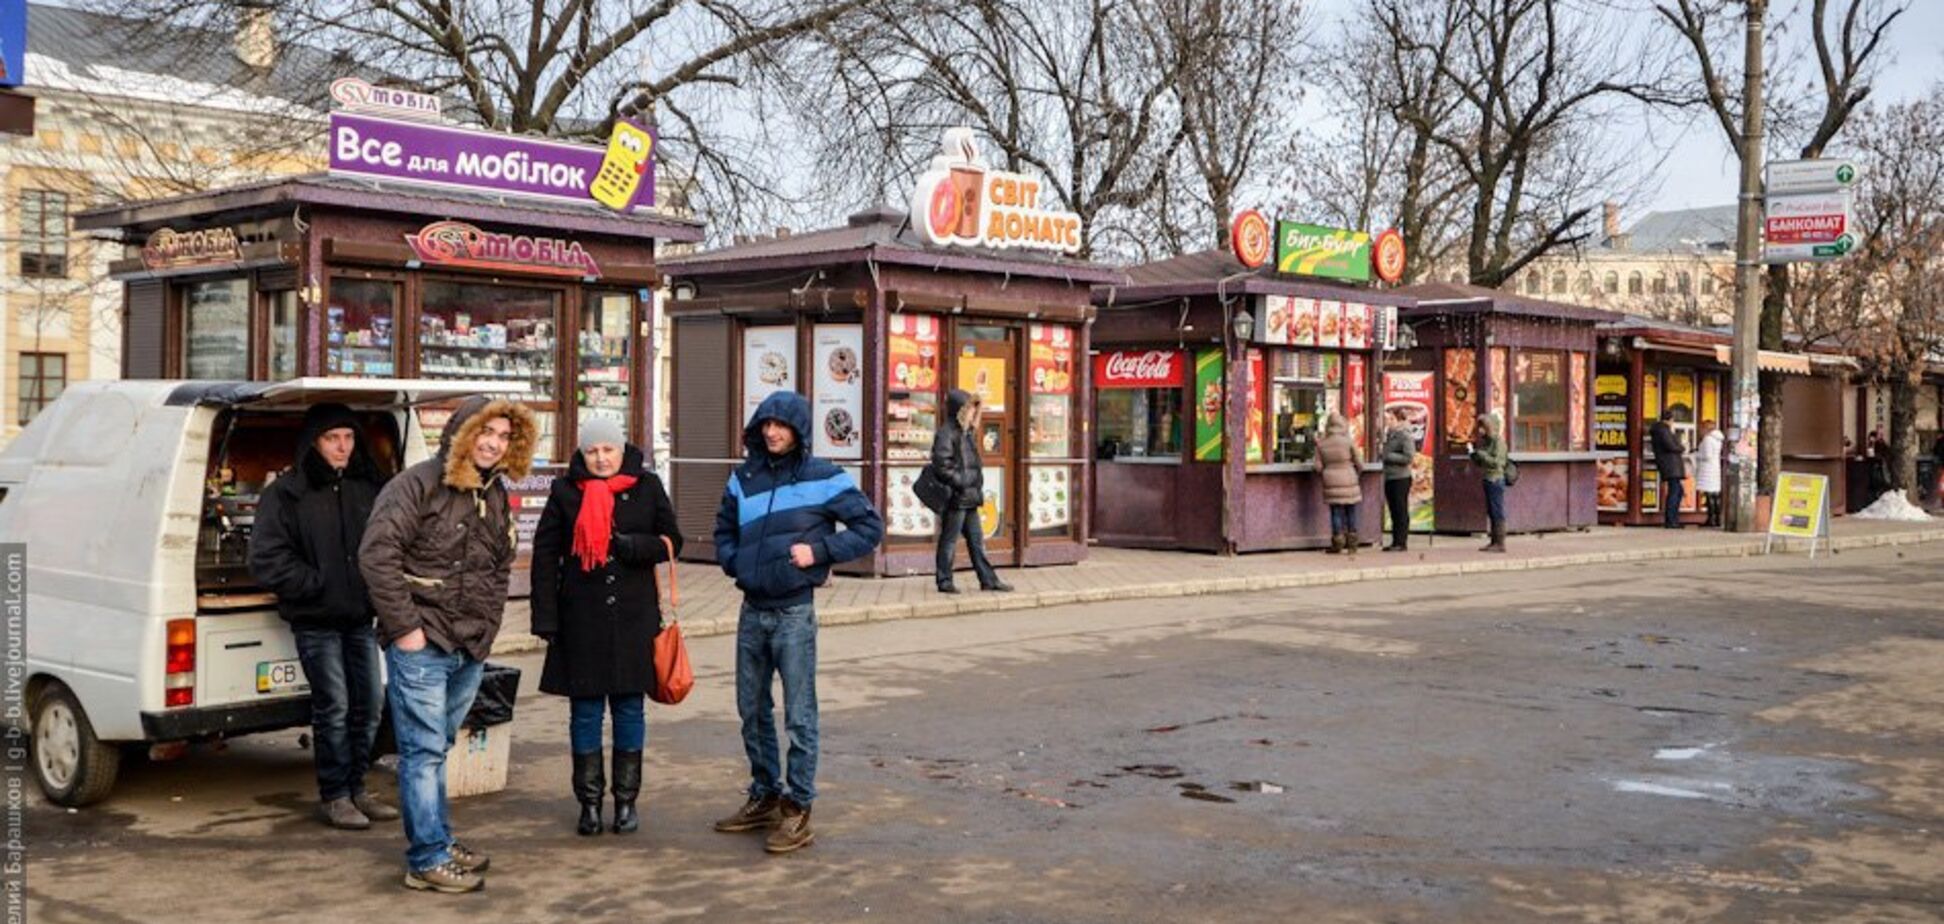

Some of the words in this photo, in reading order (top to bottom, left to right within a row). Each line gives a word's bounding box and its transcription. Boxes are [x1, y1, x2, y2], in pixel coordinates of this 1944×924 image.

[336, 126, 403, 167] Все
[407, 156, 449, 173] для
[455, 152, 586, 190] мобілок
[989, 177, 1039, 209] СВІТ
[986, 210, 1078, 247] ДОНАТС
[1768, 216, 1842, 232] БАНКОМАТ
[1105, 350, 1174, 380] Coca-Cola
